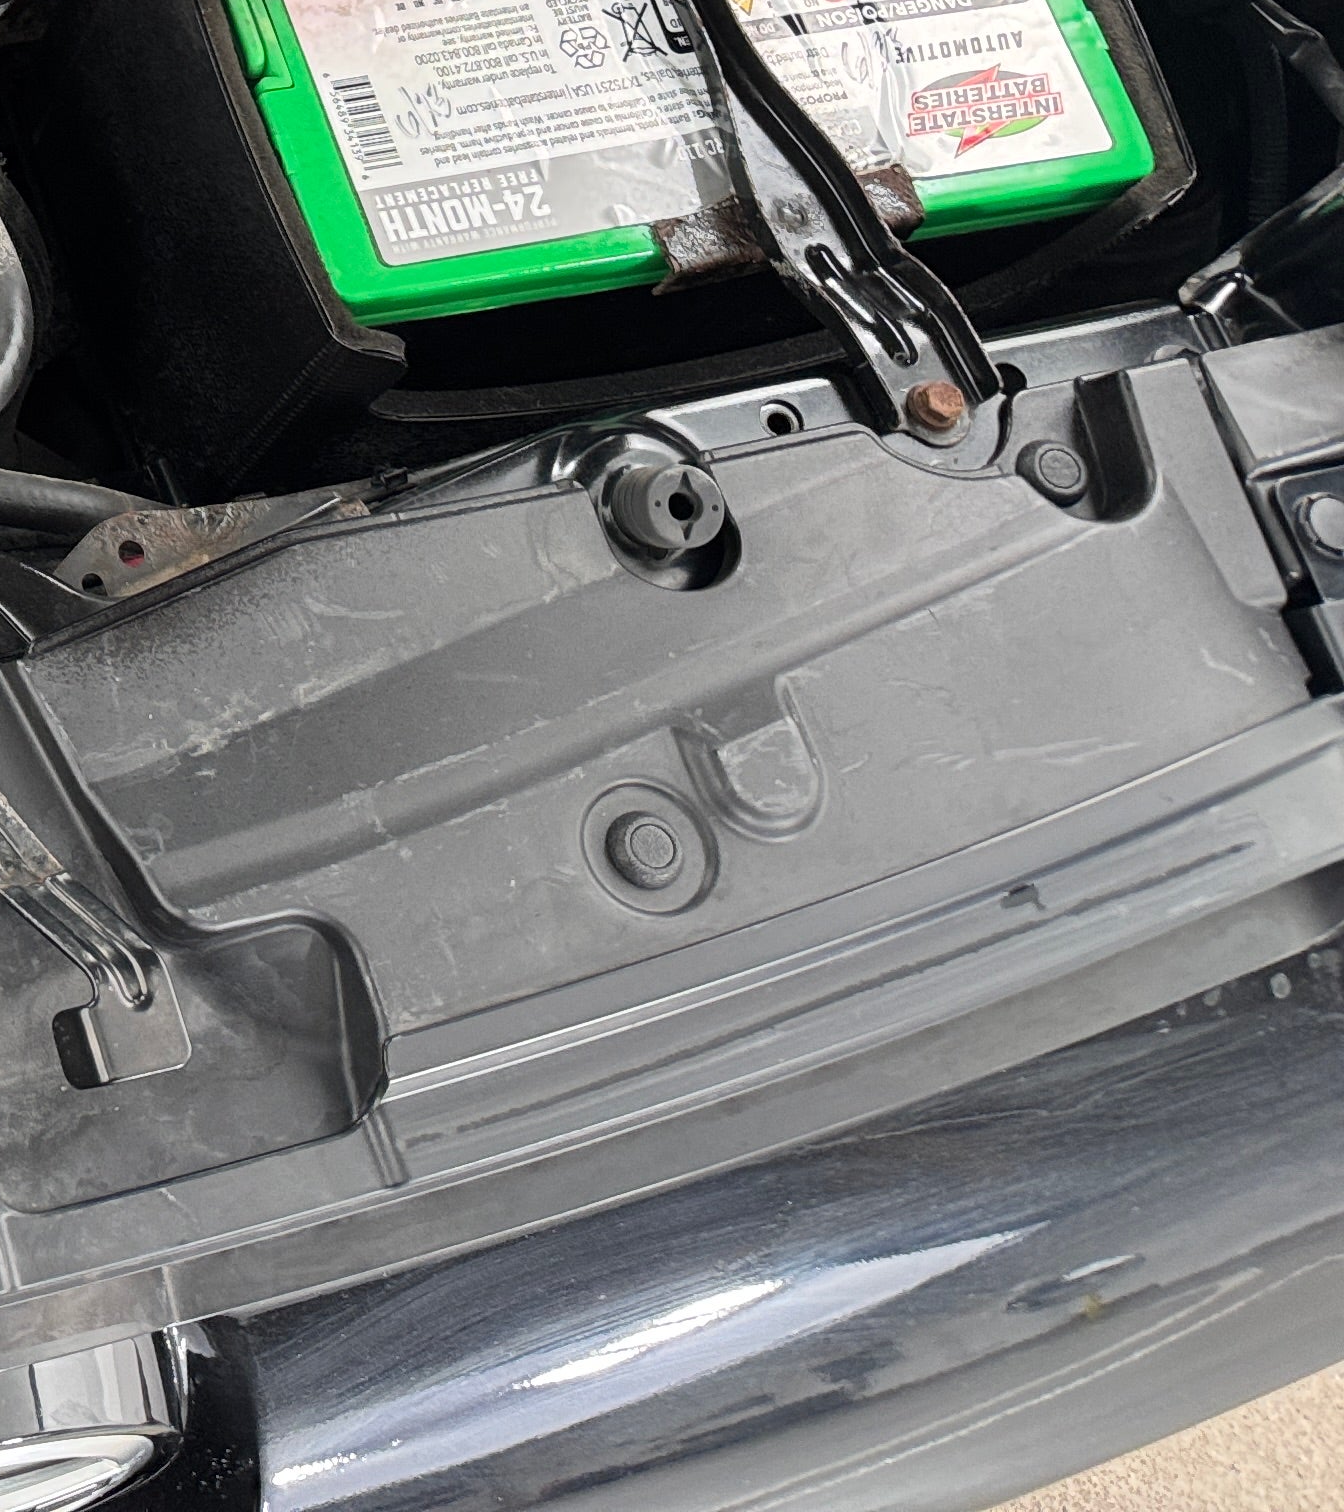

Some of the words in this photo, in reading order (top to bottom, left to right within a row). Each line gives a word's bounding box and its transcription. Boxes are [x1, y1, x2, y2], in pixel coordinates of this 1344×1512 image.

[443, 11, 479, 24] Batteries
[555, 12, 592, 25] BATTERY
[400, 18, 444, 31] authorized
[396, 35, 406, 43] or
[441, 37, 456, 46] see
[496, 37, 532, 50] Canada
[532, 34, 543, 45] In
[480, 41, 497, 53] call
[537, 48, 549, 59] In
[890, 30, 1027, 64] AUTOMOTIVE
[412, 45, 481, 64] 800.843.0200
[501, 53, 519, 65] call
[508, 64, 543, 79] replace
[542, 62, 556, 74] To
[480, 71, 510, 85] under
[627, 74, 642, 87] TX
[570, 84, 594, 98] USA
[593, 77, 628, 94] 75251
[911, 78, 1049, 109] BATTERIES
[909, 97, 1062, 130] INTERSTATE
[548, 133, 578, 147] related
[578, 130, 595, 141] and
[433, 156, 451, 166] and
[450, 152, 470, 163] lead
[495, 168, 538, 187] FREE
[371, 176, 492, 209] REPLACEMENT
[376, 182, 552, 243] 24-MONTH
[420, 229, 481, 249] WARRANTY
[390, 241, 419, 255] WITH
